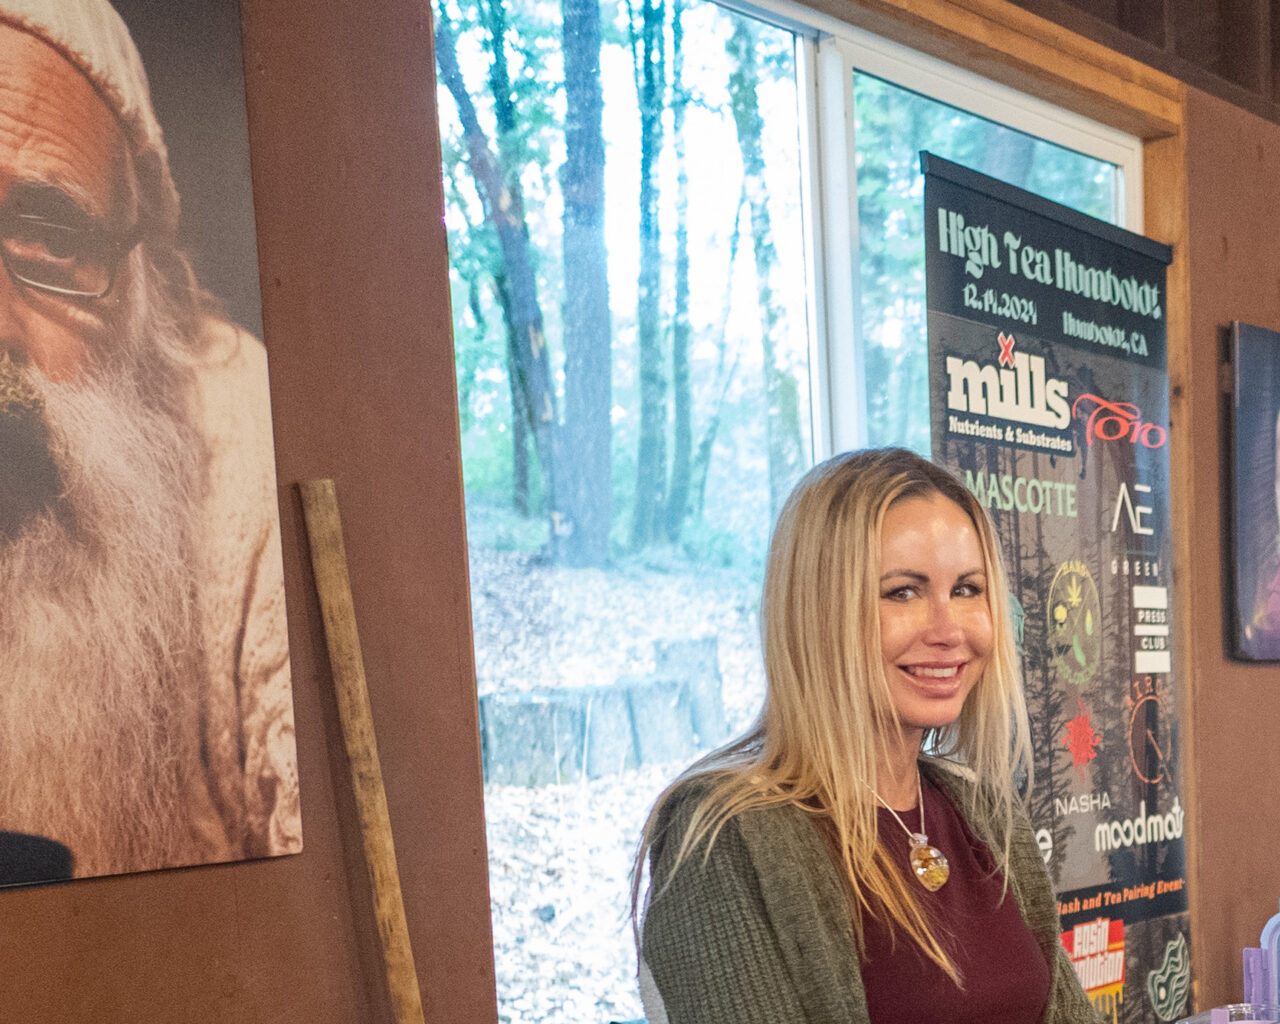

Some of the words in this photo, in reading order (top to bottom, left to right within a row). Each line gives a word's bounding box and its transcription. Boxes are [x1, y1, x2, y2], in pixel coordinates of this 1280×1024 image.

[938, 207, 1001, 279] High
[1003, 231, 1054, 285] Tea
[1054, 248, 1162, 320] Humboldt
[946, 333, 1072, 430] mills
[948, 416, 1004, 442] Nutrients
[1005, 427, 1014, 442] &
[1015, 428, 1073, 452] Substrates
[964, 469, 1079, 518] MASCOTTE
[1056, 792, 1112, 815] NASHA
[1082, 894, 1102, 910] and
[1104, 891, 1122, 906] Tea
